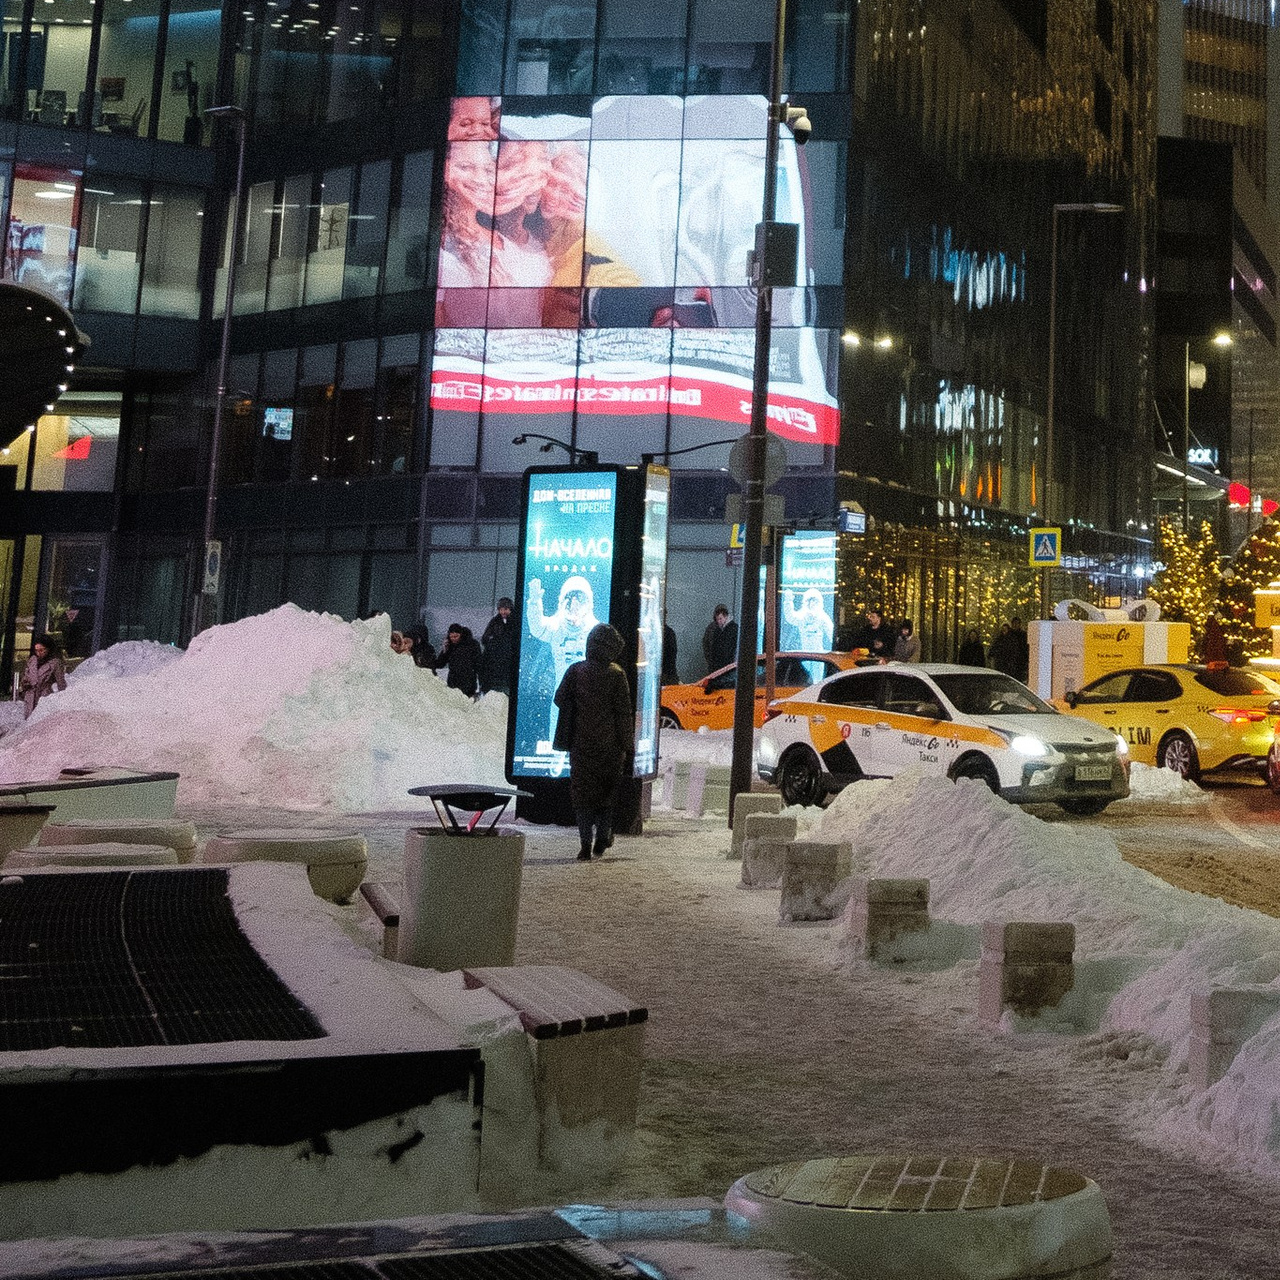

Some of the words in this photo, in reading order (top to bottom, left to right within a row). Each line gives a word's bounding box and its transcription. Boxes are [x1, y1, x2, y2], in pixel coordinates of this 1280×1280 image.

[577, 502, 611, 514] ПРЕСНЕ
[528, 532, 612, 558] НАЧАЛО
[902, 733, 927, 748] Яндекс
[927, 737, 940, 750] Go
[918, 750, 939, 763] Такси
